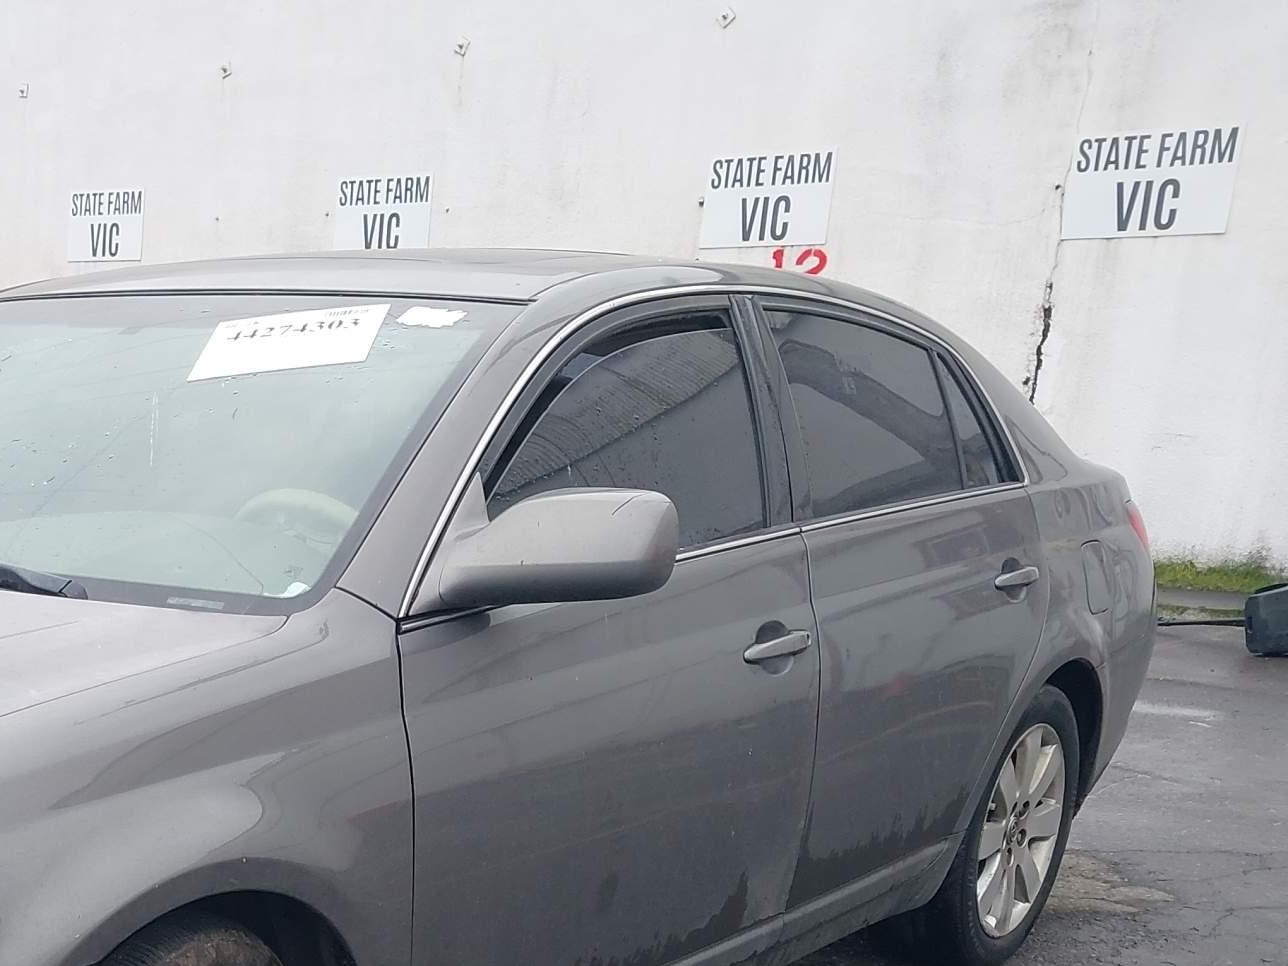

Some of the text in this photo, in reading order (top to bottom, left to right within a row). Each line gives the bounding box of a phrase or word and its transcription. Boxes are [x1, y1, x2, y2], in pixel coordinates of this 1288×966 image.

[1076, 127, 1240, 173] STATE FARM
[711, 151, 833, 190] STATE FARM
[71, 190, 142, 217] STATE FARM
[339, 176, 430, 207] STATE FARM
[1115, 178, 1181, 233] VIC
[363, 212, 401, 250] VIC
[740, 194, 792, 243] VIC
[89, 222, 120, 257] VIC
[226, 317, 361, 342] 44274303
